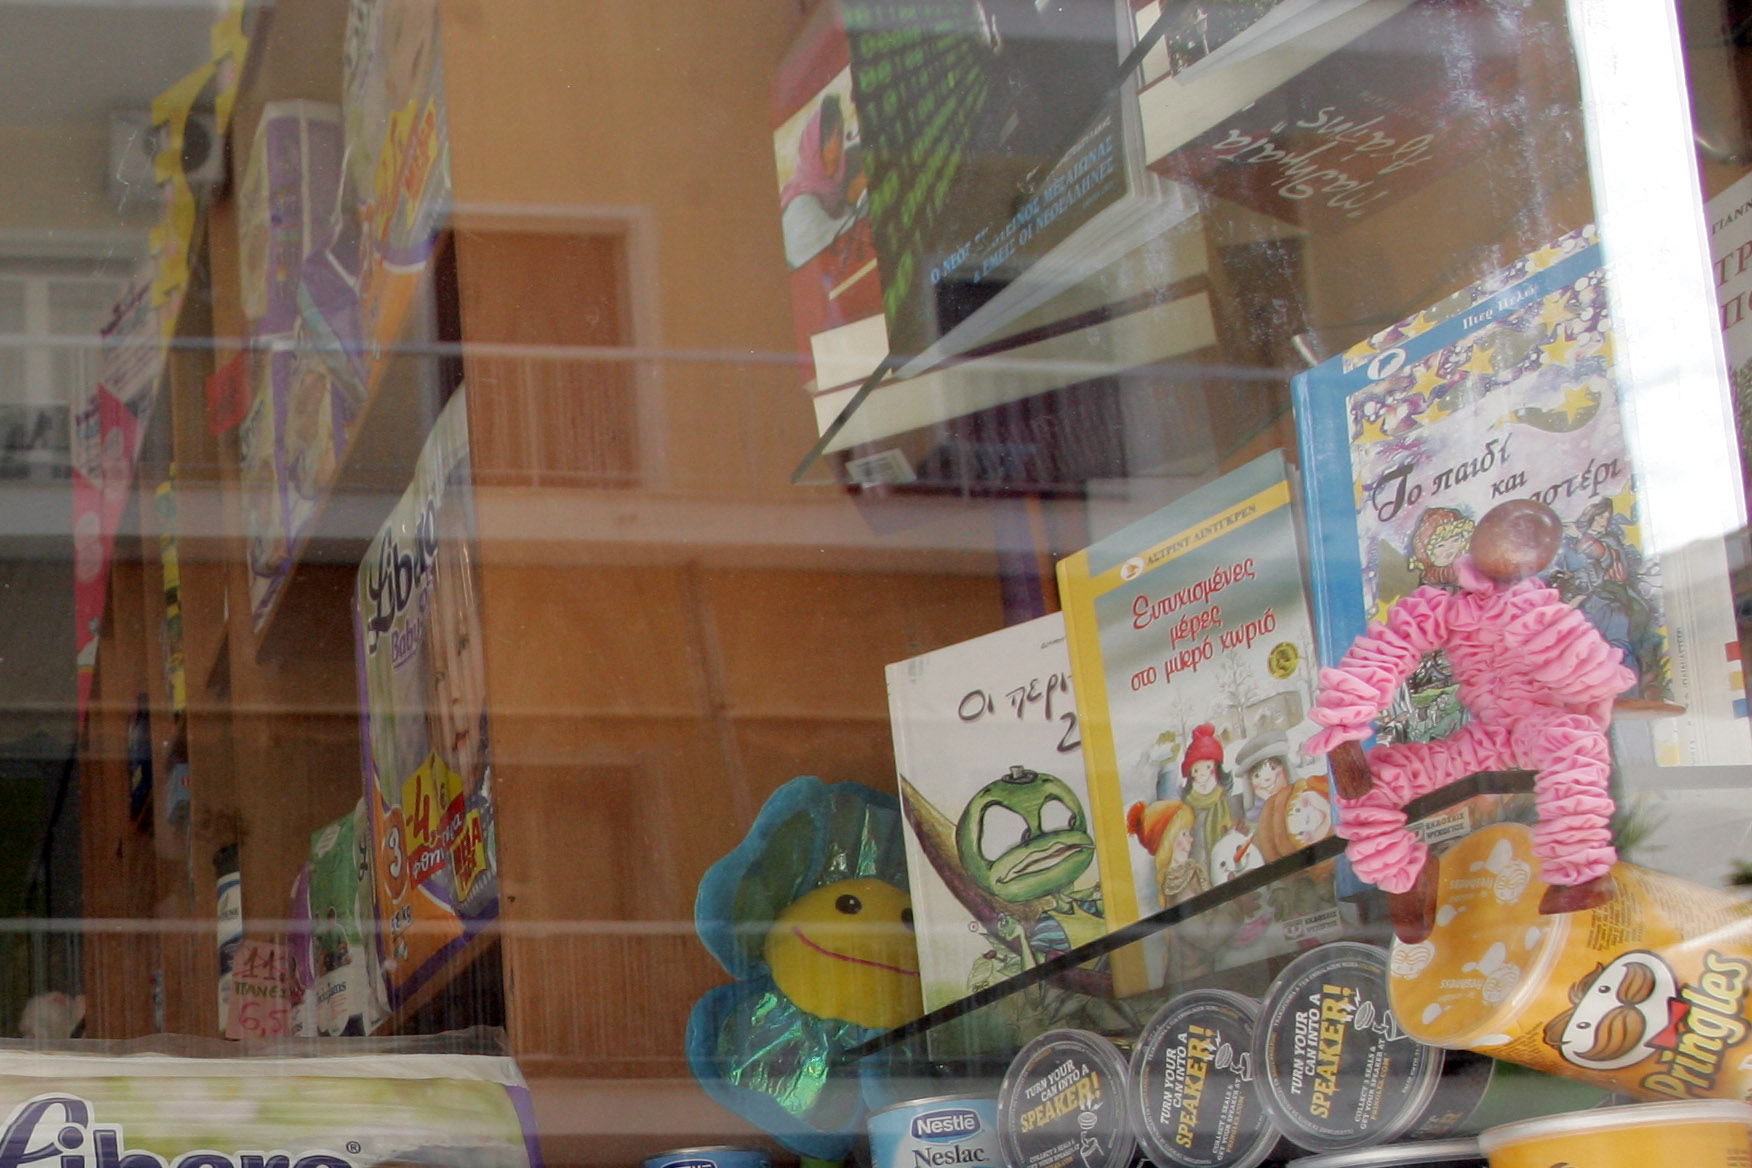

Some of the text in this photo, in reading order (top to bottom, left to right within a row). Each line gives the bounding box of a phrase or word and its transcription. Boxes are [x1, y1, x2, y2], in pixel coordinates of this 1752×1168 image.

[1372, 432, 1512, 522] Το παιδί
[1490, 470, 1528, 499] και
[1144, 503, 1257, 566] ΑΣΤΡΙΝΤ ΛΙΝΤΓΚΡΕΝ
[1132, 557, 1256, 631] Ευτυχισμένες
[1130, 608, 1277, 693] στο μικρό χωριό
[1170, 605, 1224, 651] μέρες
[957, 688, 995, 724] Οι
[1291, 1010, 1308, 1096] TURN YOUR
[1304, 1008, 1320, 1077] CAN INTO
[1309, 983, 1354, 1120] SPEAKER!
[1644, 952, 1748, 1099] Pringles
[1020, 1071, 1103, 1133] SPEAKER!
[1025, 1058, 1076, 1099] TURN YOUR
[1040, 1069, 1081, 1102] CAN INTO
[1160, 1047, 1177, 1126] TURN YOUR
[1173, 1046, 1187, 1108] CAN INTO
[1175, 1024, 1216, 1149] SPEAKER!
[911, 1145, 987, 1168] Neslac
